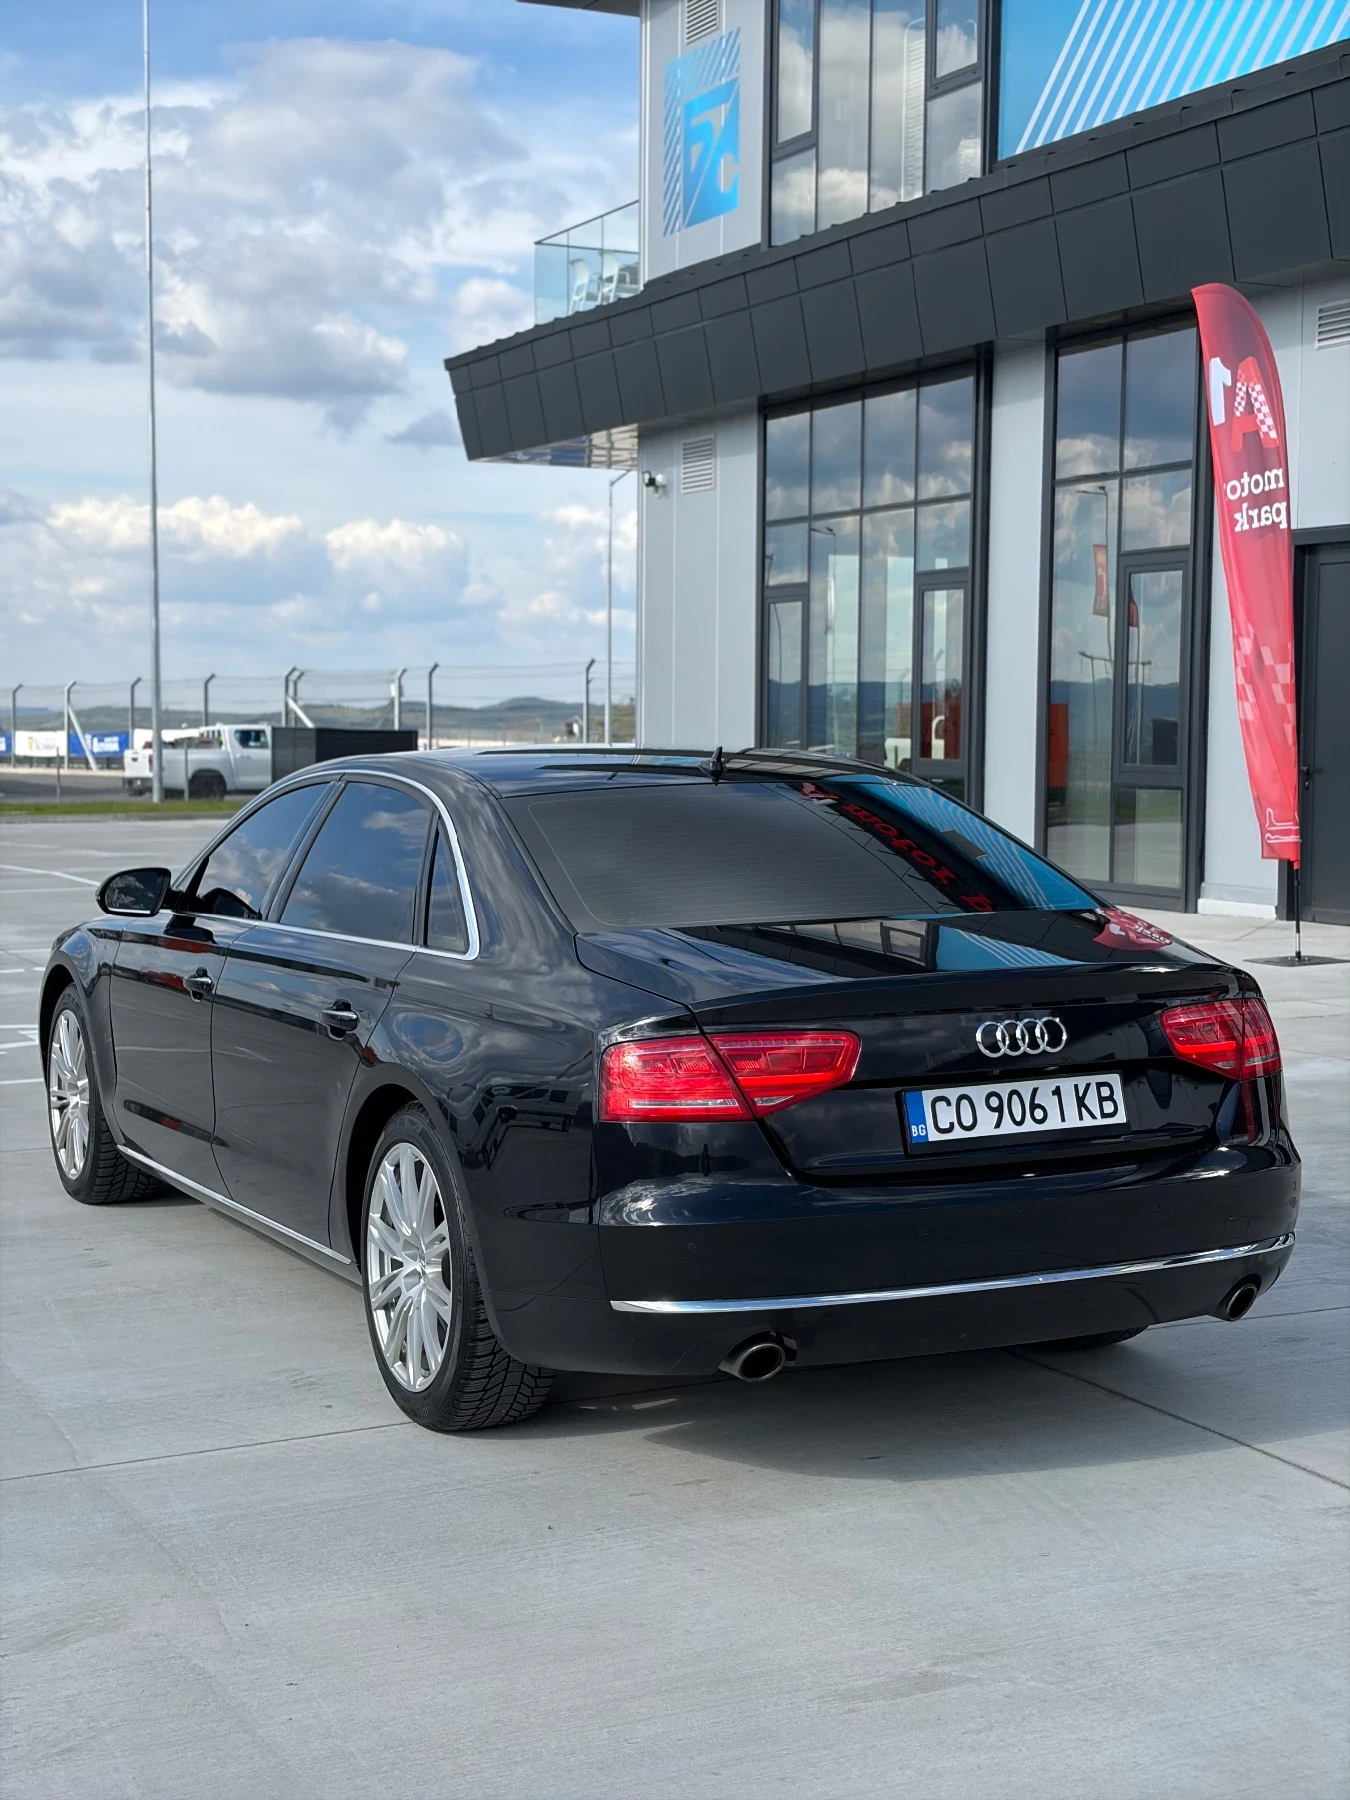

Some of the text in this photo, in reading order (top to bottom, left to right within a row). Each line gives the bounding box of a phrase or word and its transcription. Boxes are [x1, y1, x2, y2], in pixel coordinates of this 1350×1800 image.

[930, 1081, 1119, 1134] CO 9061 KB
[911, 1124, 926, 1137] BG
